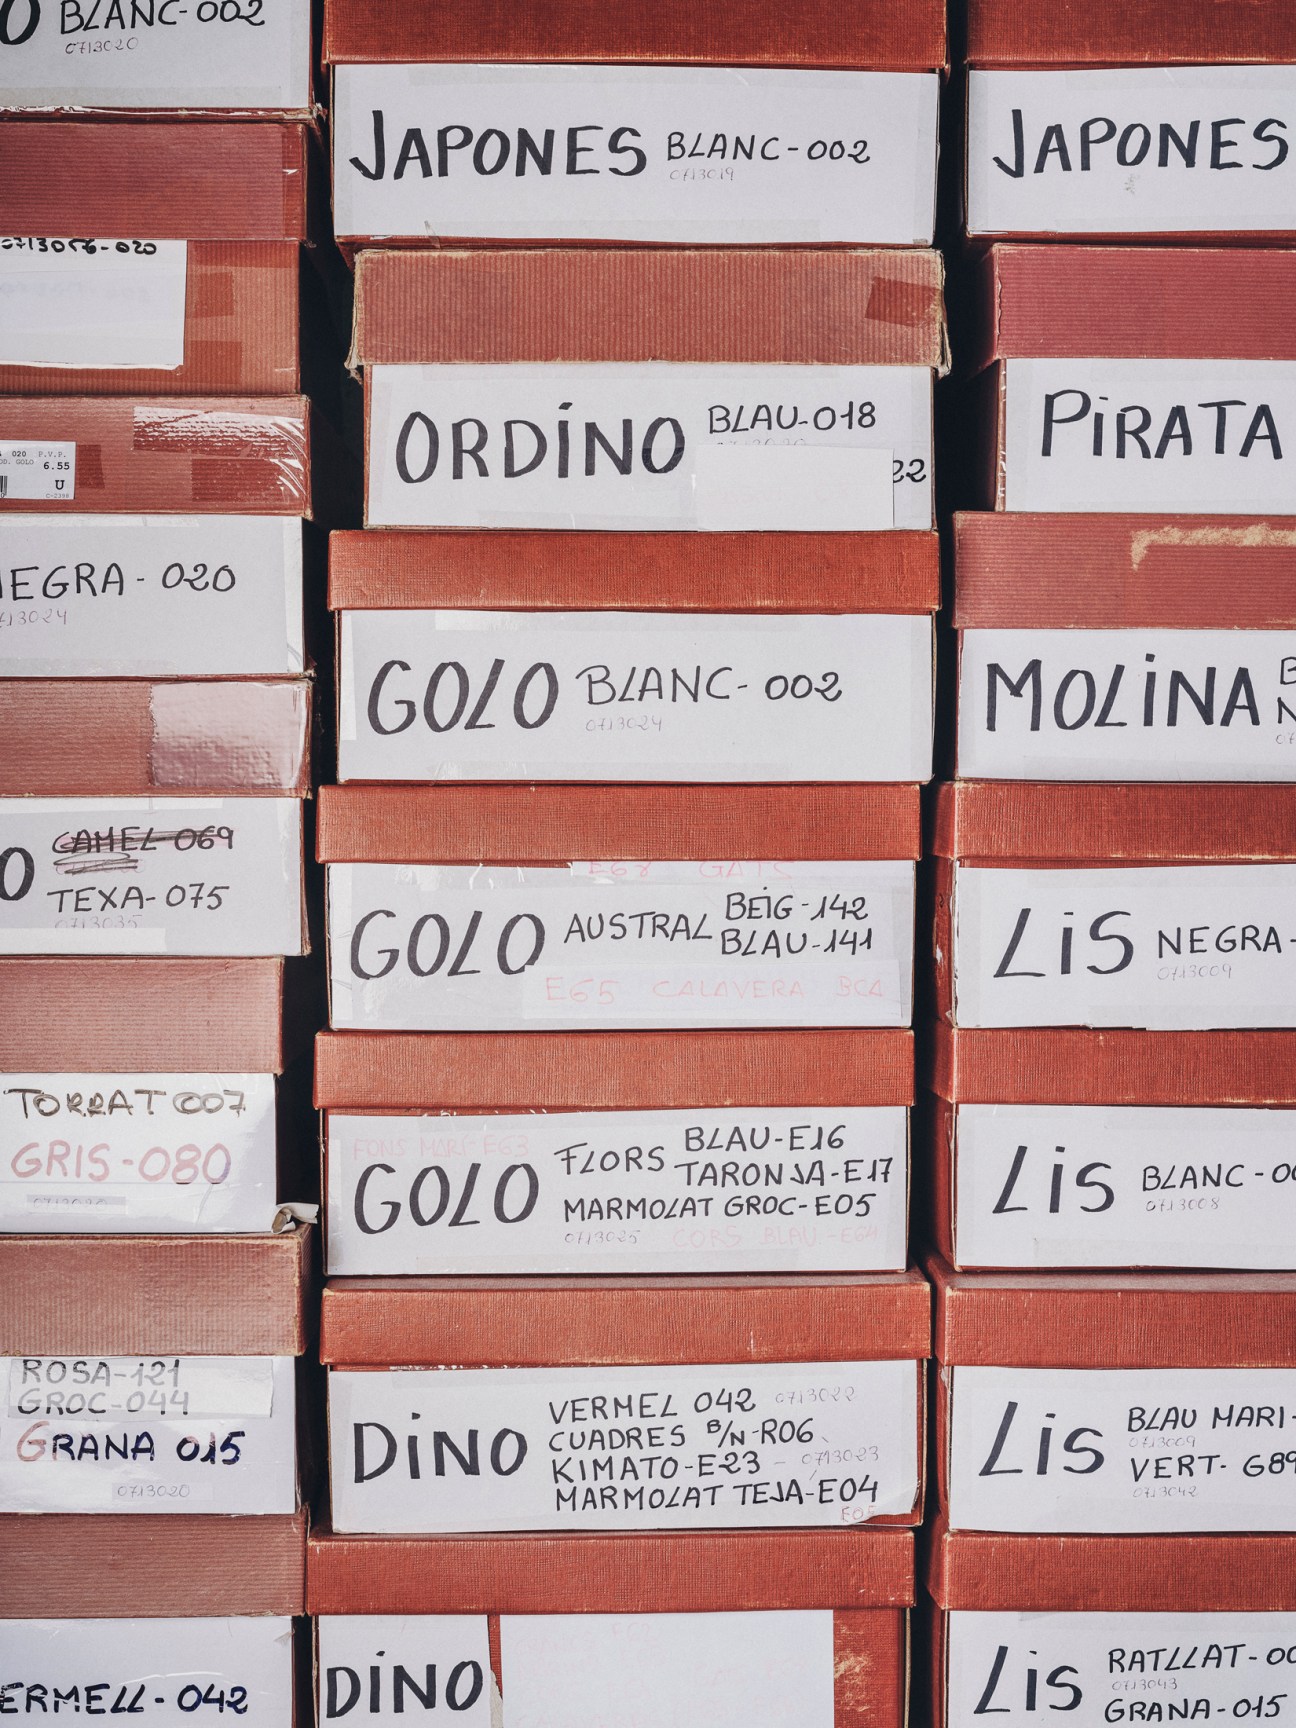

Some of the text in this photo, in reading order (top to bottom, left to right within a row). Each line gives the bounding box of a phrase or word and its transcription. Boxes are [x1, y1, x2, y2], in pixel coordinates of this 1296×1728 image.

[349, 110, 870, 180] JAPONES BLANC-002
[993, 109, 1289, 178] JAPONES
[708, 401, 876, 434] BLAU-018
[43, 461, 70, 470] 6.55
[55, 480, 65, 490] U
[368, 658, 559, 735] GOLO
[586, 715, 662, 732] 0713024
[0, 846, 35, 902] O
[350, 908, 546, 980] GOLO
[564, 912, 713, 944] AUSTRAL
[720, 928, 873, 958] BLAU-141
[545, 976, 619, 1005] E65
[652, 979, 805, 1000] CALAVERA
[3, 1088, 246, 1119] TORRAT 007
[685, 1124, 847, 1153] BLAU-E16
[10, 1139, 232, 1185] GRIS-080
[354, 1142, 893, 1235] GOLO FLORS TARONJA-E17
[564, 1193, 877, 1222] MARMOLAT GROC-E05
[21, 1358, 181, 1387] ROSA-121
[17, 1387, 189, 1415] GROC-044
[549, 1392, 678, 1425] VERMEL
[694, 1387, 756, 1413] 042
[1127, 1406, 1197, 1433] BLAU
[16, 1420, 246, 1465] GRANA 015
[548, 1424, 686, 1453] CUADRES
[552, 1450, 761, 1484] KIMATO-E23
[117, 1484, 191, 1498] 0713020
[555, 1474, 879, 1511] MARMOLAT TEJA-E04
[1104, 1693, 1288, 1723] GRANA-015
